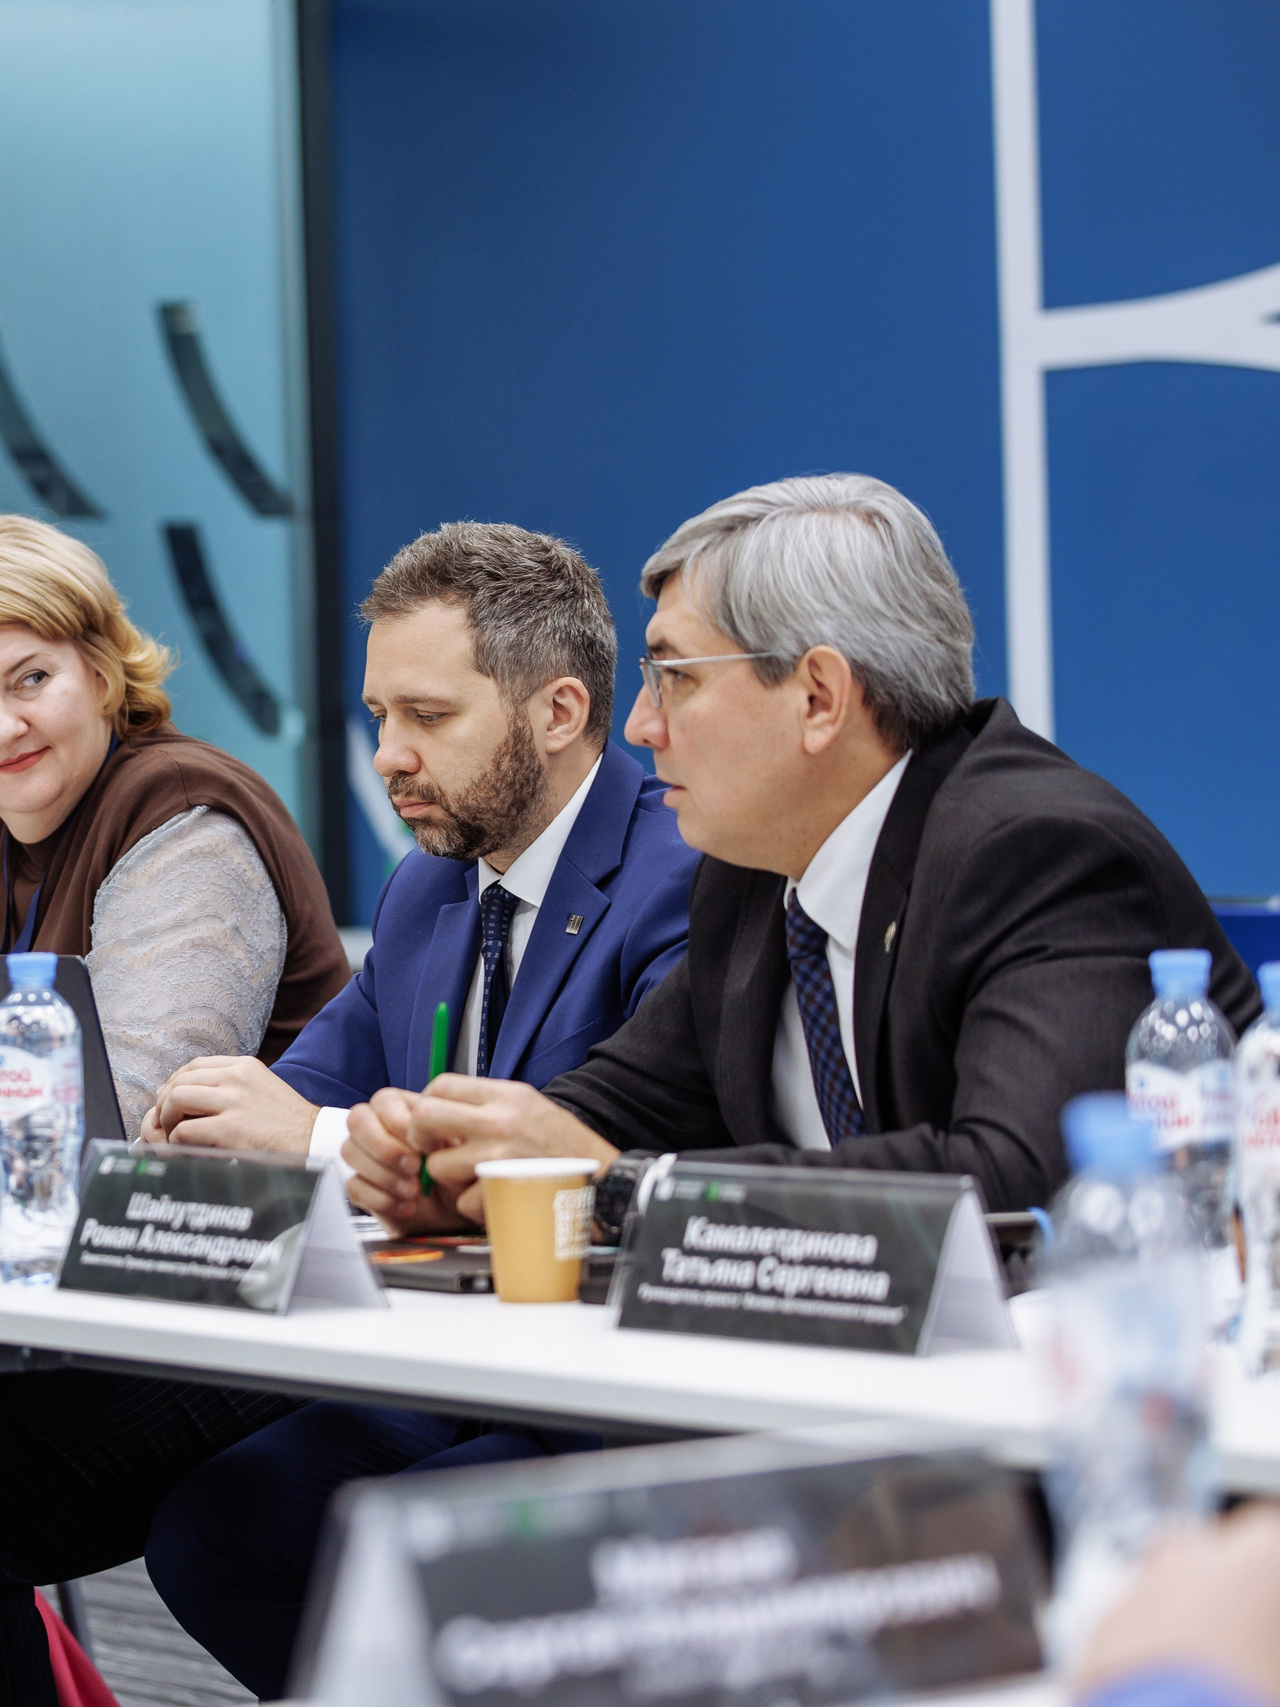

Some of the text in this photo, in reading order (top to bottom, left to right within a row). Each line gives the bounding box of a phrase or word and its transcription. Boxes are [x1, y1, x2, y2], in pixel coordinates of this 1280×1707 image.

[79, 1217, 140, 1249] Роман
[661, 1248, 891, 1302] Татьяна Сергеевна
